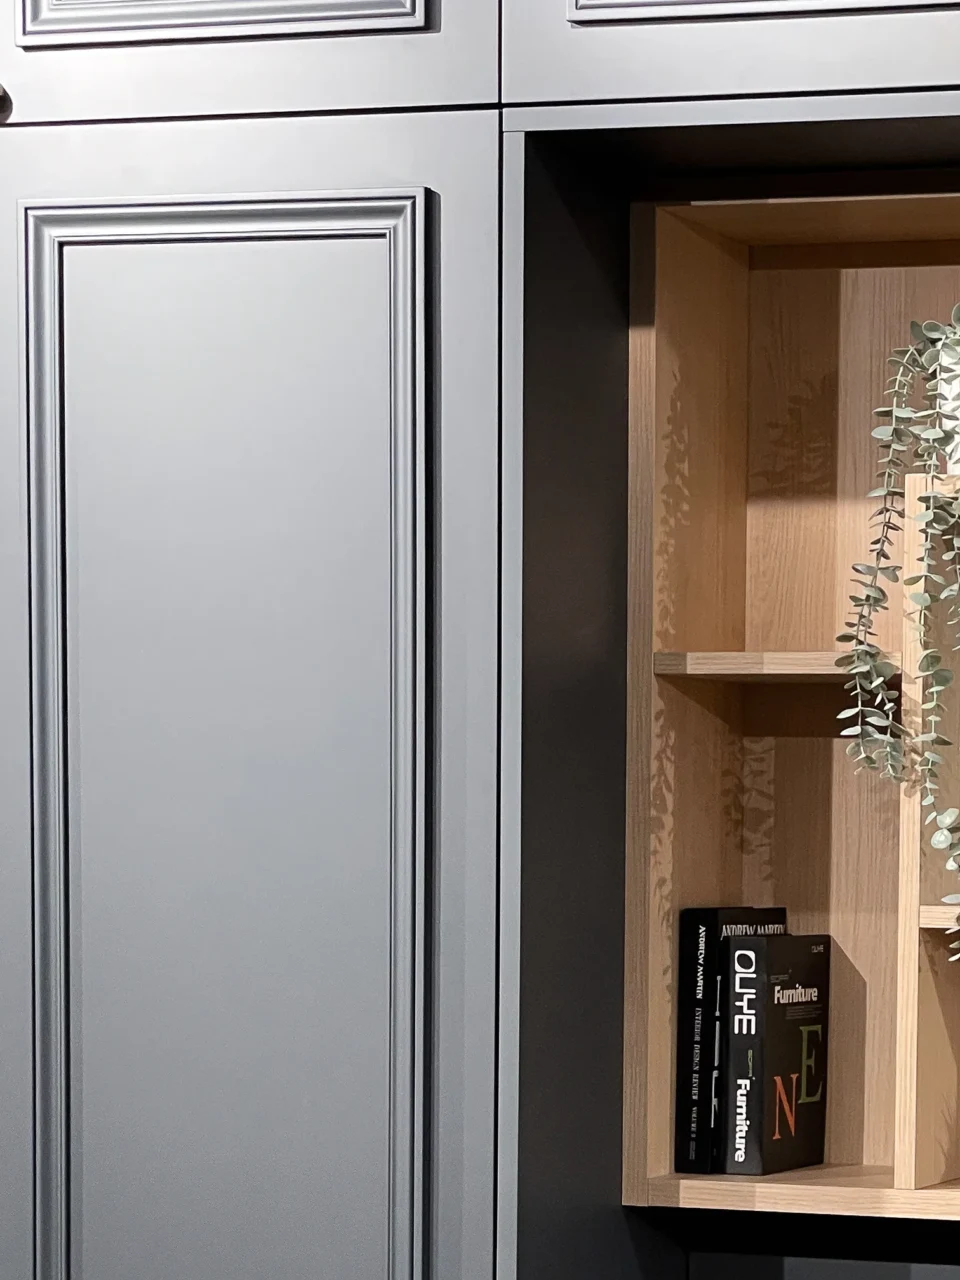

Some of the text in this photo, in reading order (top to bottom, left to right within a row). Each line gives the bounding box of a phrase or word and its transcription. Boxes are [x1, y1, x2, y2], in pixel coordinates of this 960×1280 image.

[774, 983, 819, 1005] Furniture
[693, 1007, 702, 1041] INTERIOR
[692, 1044, 700, 1071] DESIGN
[734, 1078, 751, 1163] Furniture
